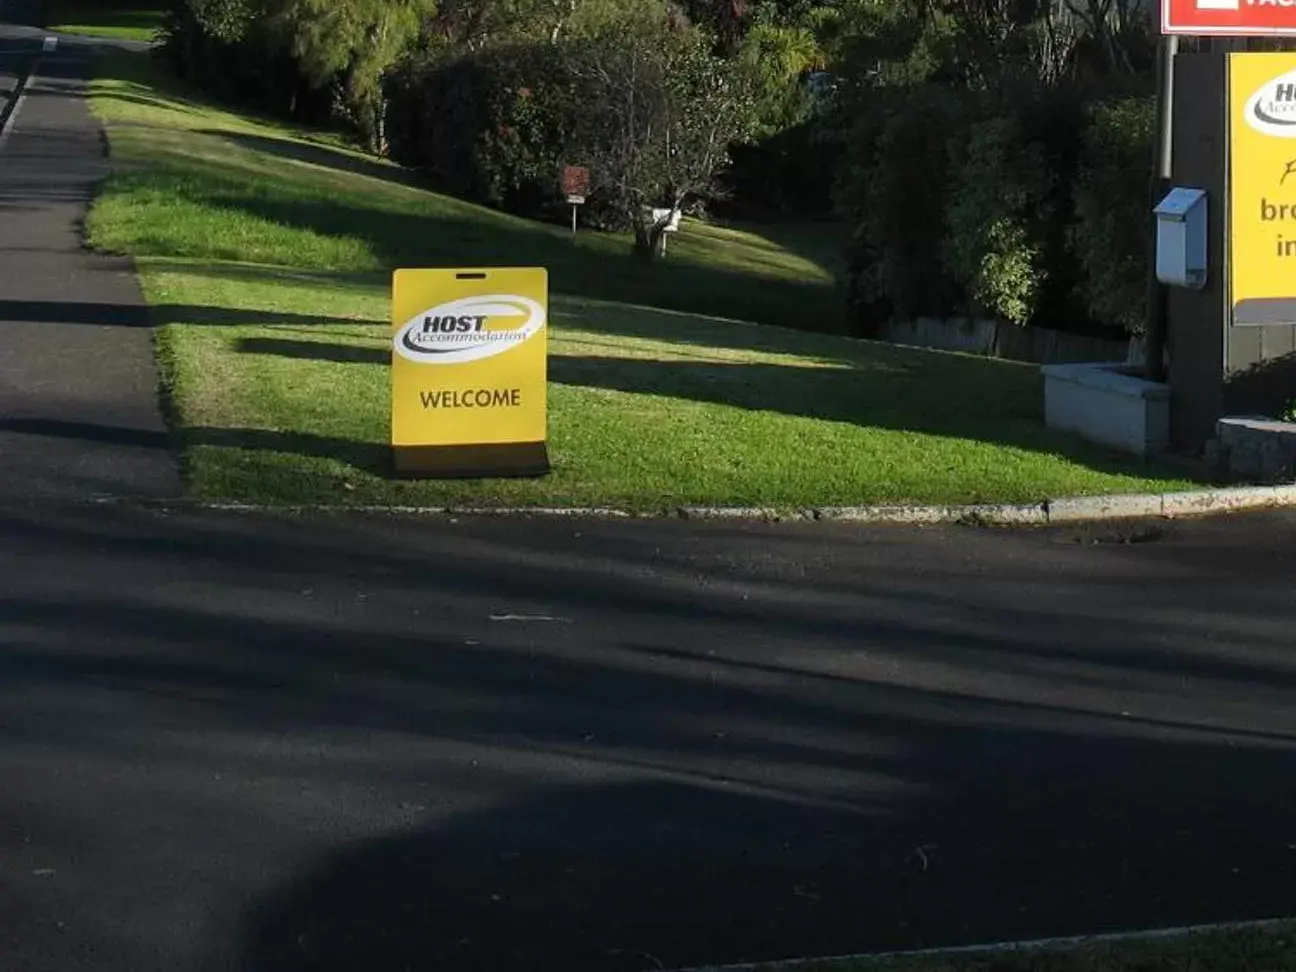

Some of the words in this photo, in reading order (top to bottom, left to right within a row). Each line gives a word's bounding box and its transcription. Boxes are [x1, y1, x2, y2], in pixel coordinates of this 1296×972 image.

[422, 315, 487, 333] HOST
[412, 330, 527, 343] Accommodation
[420, 389, 521, 408] WELCOME
